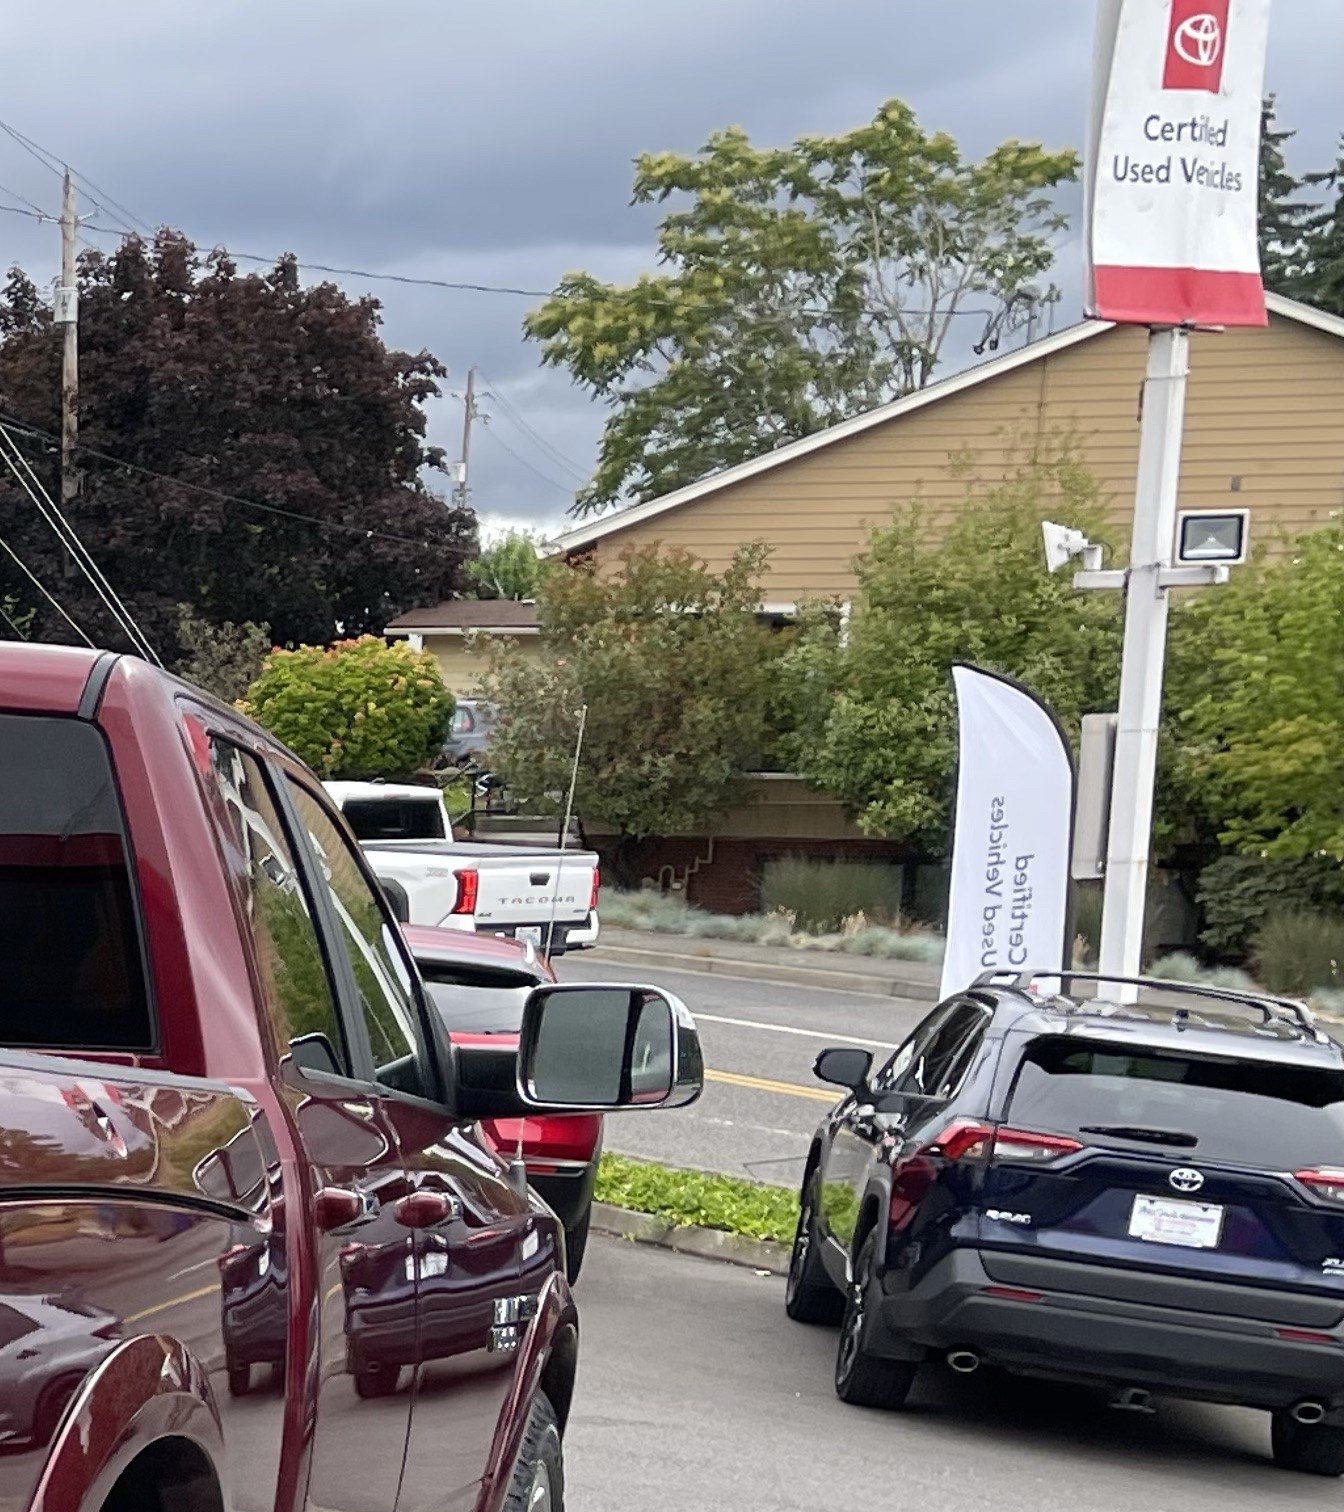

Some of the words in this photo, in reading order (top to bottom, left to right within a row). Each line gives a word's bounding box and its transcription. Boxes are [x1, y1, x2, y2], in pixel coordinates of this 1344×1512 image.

[1143, 114, 1229, 147] Certied
[1113, 154, 1172, 183] Used
[1180, 157, 1242, 192] Veicles
